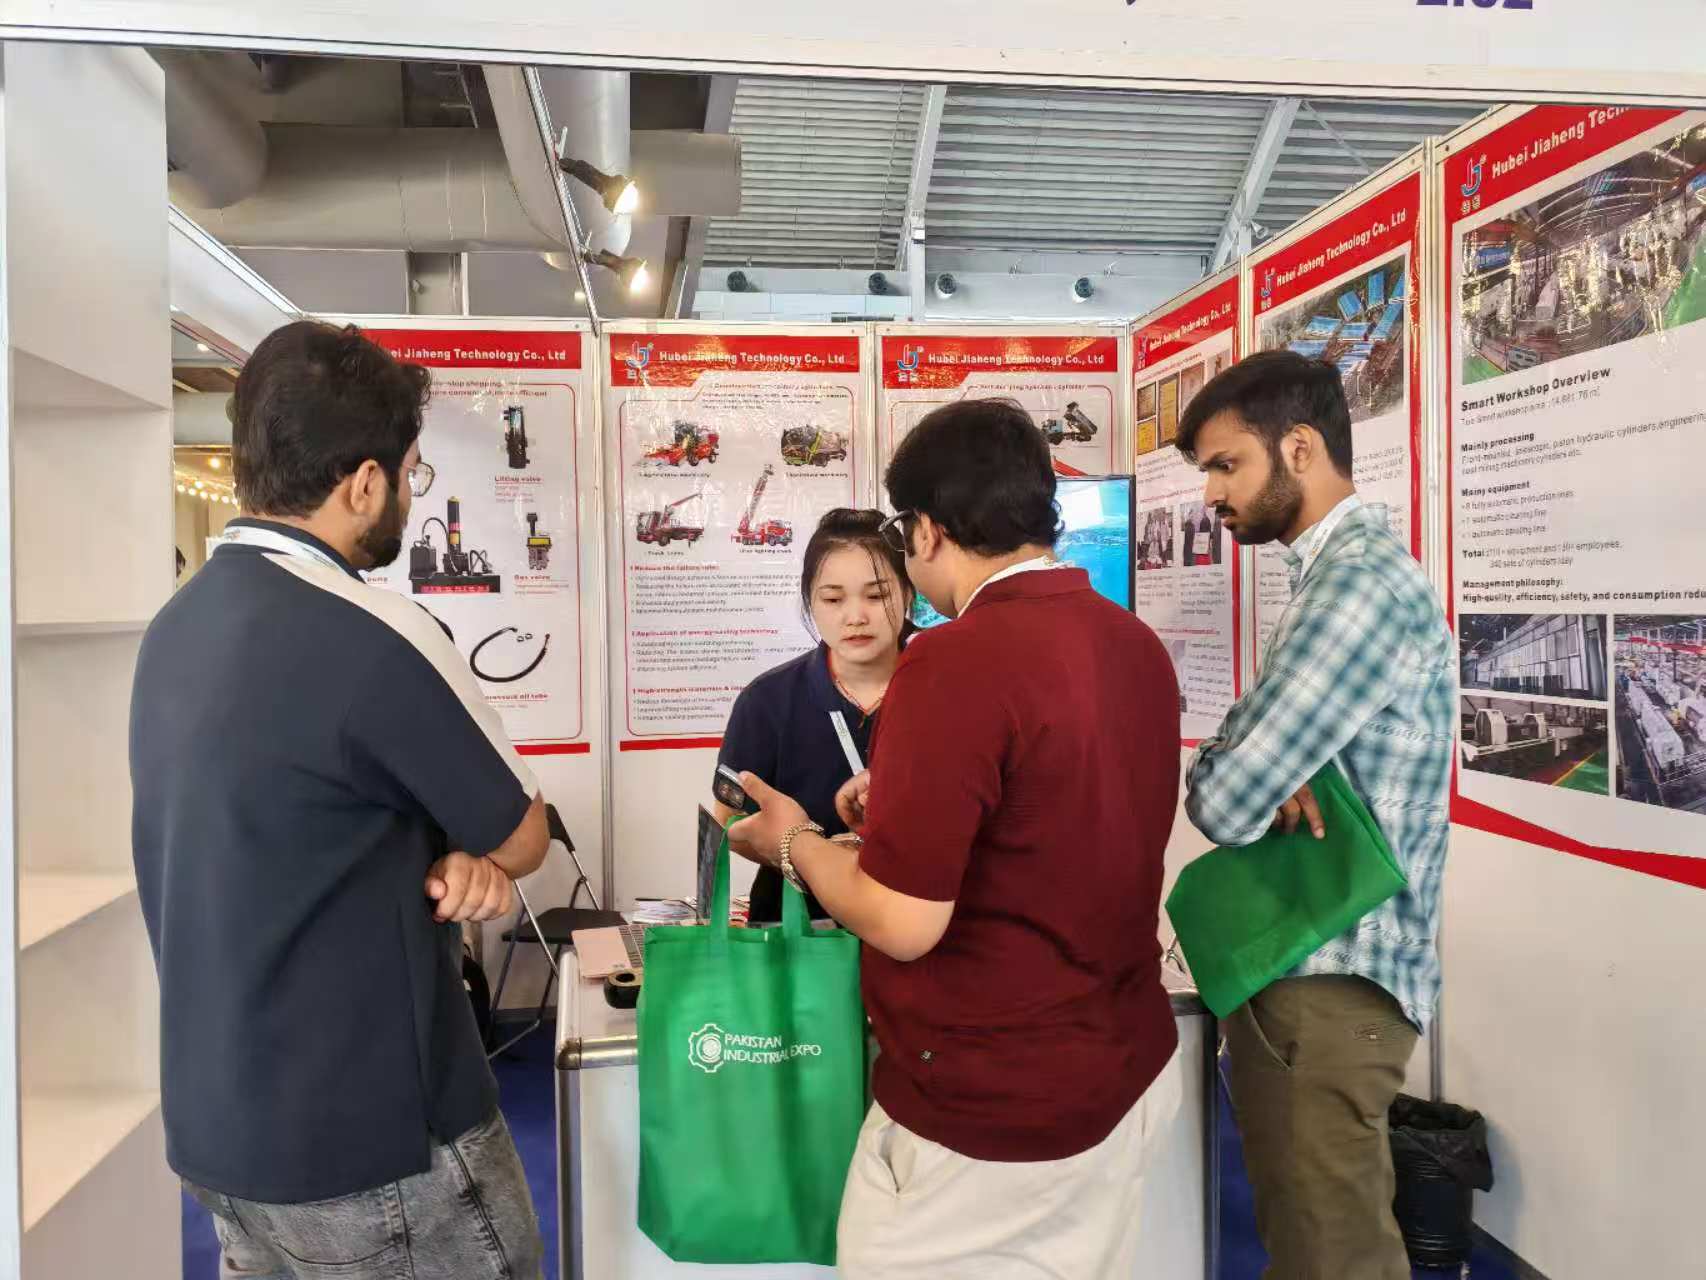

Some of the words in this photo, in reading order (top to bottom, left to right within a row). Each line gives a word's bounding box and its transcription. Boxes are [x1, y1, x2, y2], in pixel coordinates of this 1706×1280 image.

[1492, 146, 1528, 179] Hubei
[1531, 121, 1585, 160] Jiaheng
[1326, 229, 1371, 262] Technology
[1391, 208, 1406, 227] Ltd
[404, 349, 451, 361] Jiaheng
[453, 348, 520, 362] Technology
[523, 349, 545, 361] Co.,
[548, 350, 566, 361] Ltd
[659, 351, 692, 362] Hubei
[740, 351, 802, 365] Technology
[804, 353, 825, 365] Co.,
[827, 353, 845, 364] Ltd
[928, 353, 958, 364] Hubei
[960, 353, 1002, 366] Jiaheng
[1087, 355, 1104, 364] Ltd
[1461, 393, 1495, 412] Smart
[1496, 381, 1550, 404] Workshop
[1552, 368, 1611, 390] Overview
[1490, 433, 1535, 448] processing
[1576, 429, 1615, 444] hydraulic
[1487, 480, 1530, 494] equipment
[1462, 580, 1515, 590] Management
[1515, 577, 1564, 589] philosophy:
[1462, 593, 1514, 603] High-quality,
[1516, 591, 1559, 602] efficiency,
[1560, 591, 1591, 602] safety,
[1592, 592, 1611, 600] and
[1612, 591, 1681, 602] consumption
[724, 1033, 782, 1048] PAKISTAN
[723, 1049, 788, 1064] INDUSTRIAL
[790, 1044, 823, 1056] EXPO
